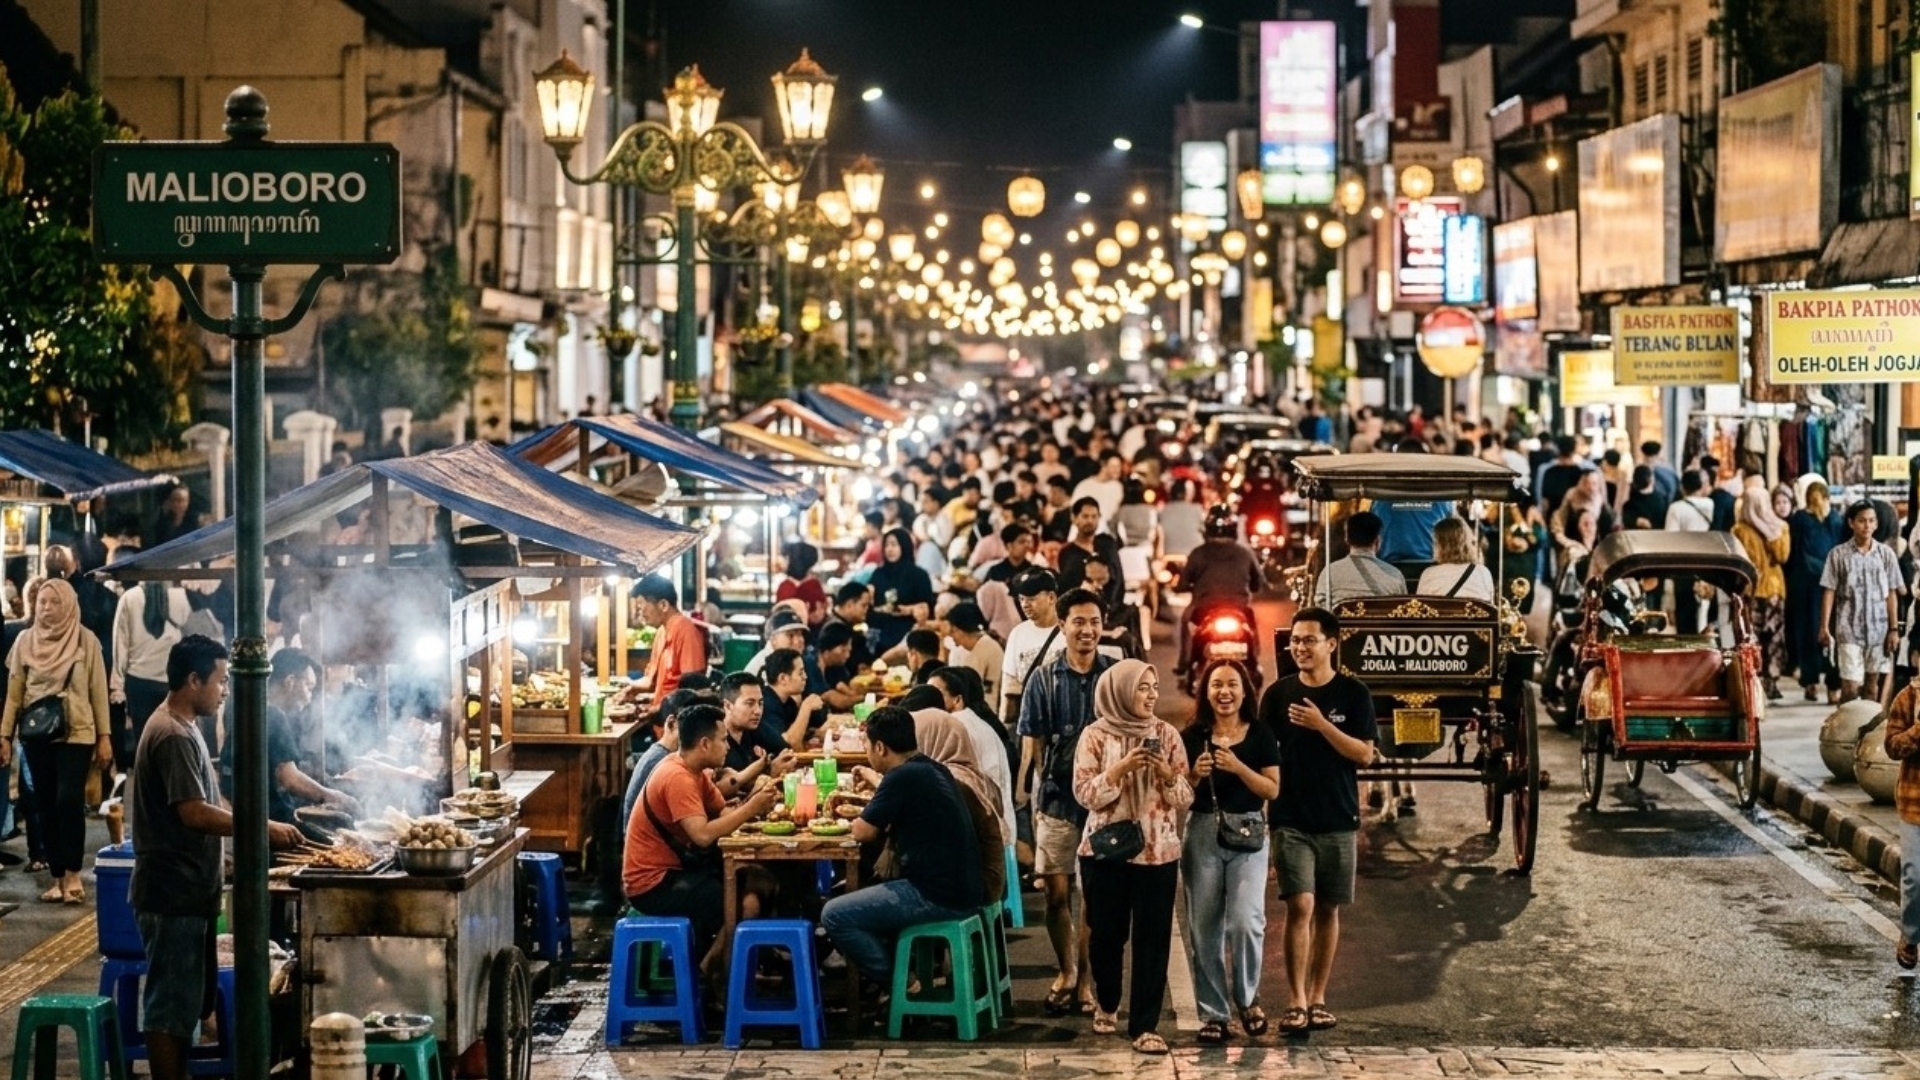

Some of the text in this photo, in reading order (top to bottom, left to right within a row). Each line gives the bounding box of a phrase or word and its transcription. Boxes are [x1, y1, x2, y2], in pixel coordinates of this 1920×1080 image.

[127, 172, 366, 202] MALIOBORO
[1778, 300, 1846, 318] BAKPIA
[1623, 336, 1681, 353] TERANG
[1778, 356, 1868, 373] OLEH-OLEH
[1360, 635, 1469, 656] ANDONG
